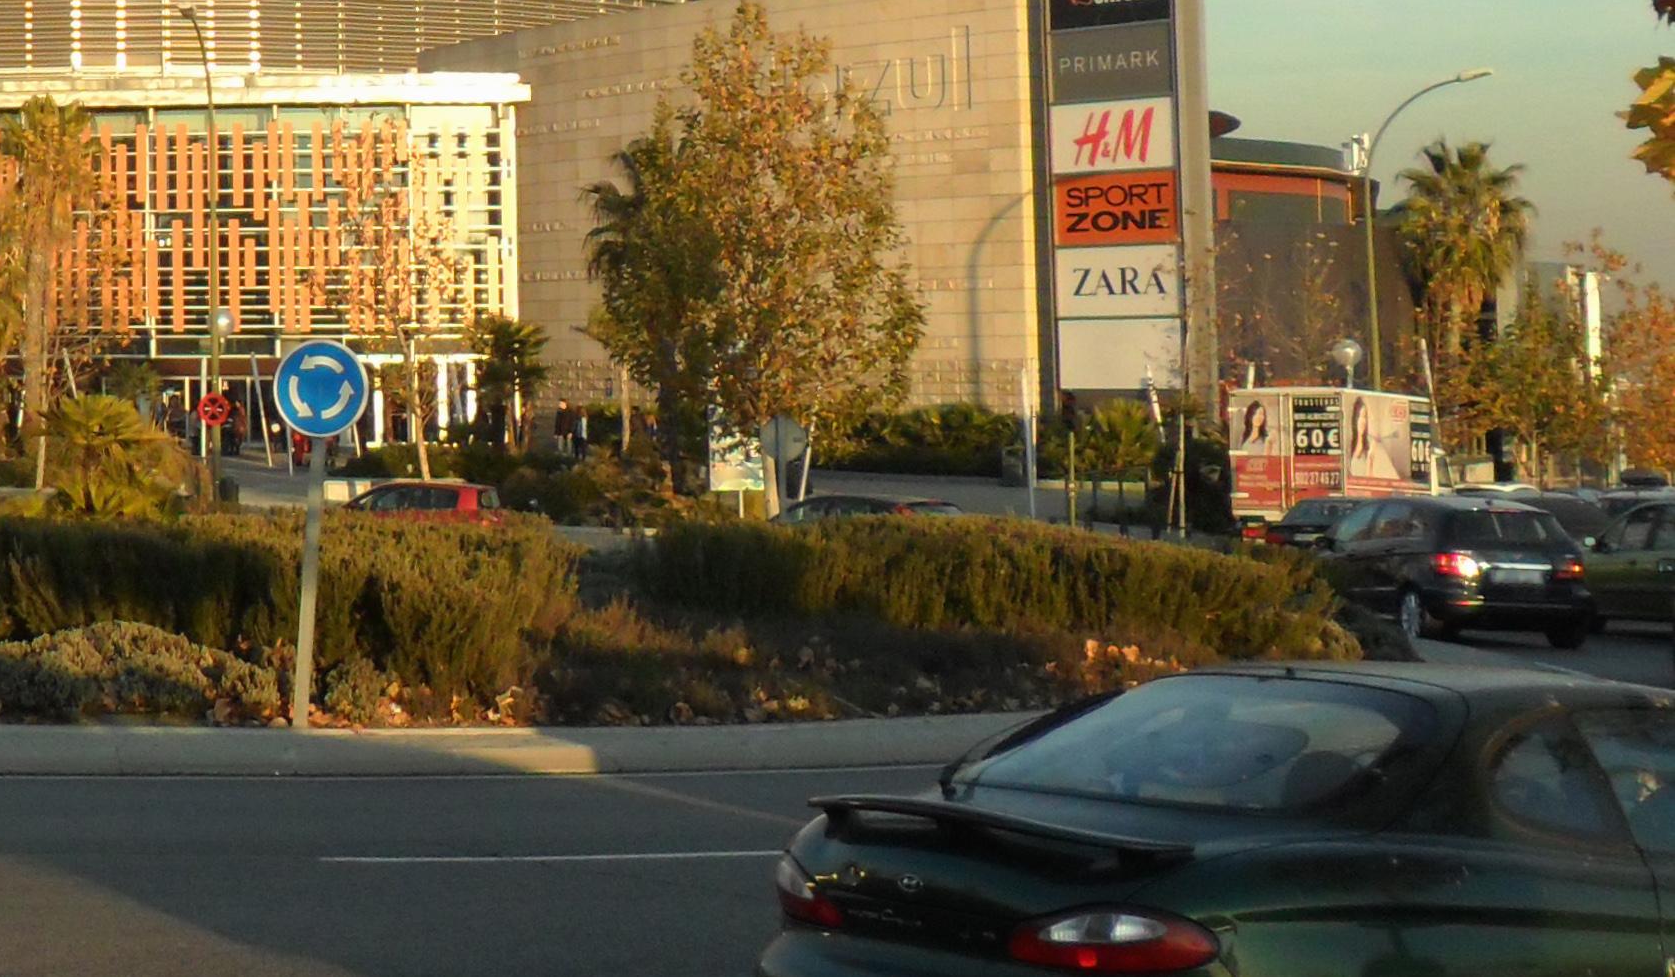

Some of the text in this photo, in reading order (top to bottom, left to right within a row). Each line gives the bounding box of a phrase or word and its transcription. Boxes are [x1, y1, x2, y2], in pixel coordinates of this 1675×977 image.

[1059, 49, 1159, 75] PRIMARK
[1073, 106, 1154, 168] H&M
[1066, 182, 1170, 209] SPORT
[1066, 209, 1170, 234] ZONE
[1073, 267, 1167, 298] ZARA
